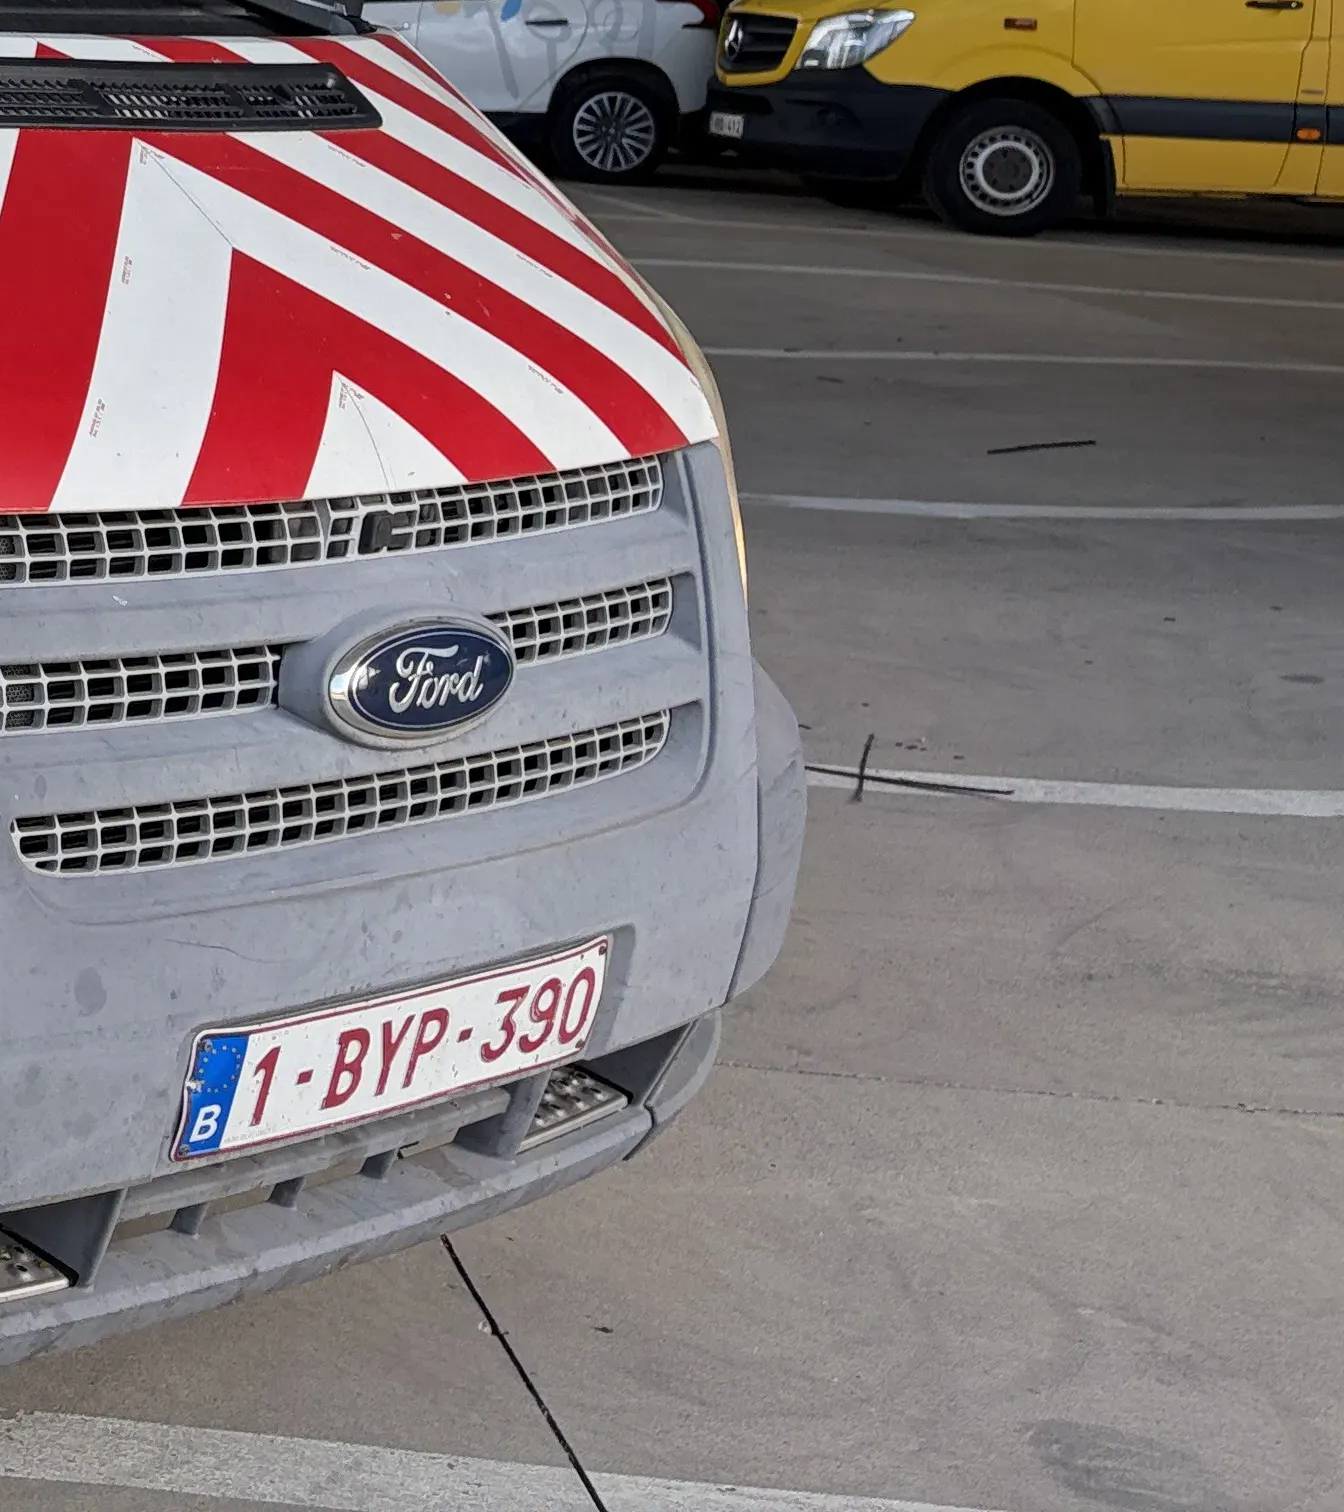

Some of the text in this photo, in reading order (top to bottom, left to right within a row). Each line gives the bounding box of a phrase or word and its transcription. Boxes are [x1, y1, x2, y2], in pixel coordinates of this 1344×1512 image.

[388, 644, 484, 714] Ford
[249, 966, 596, 1127] 1-BYP-390
[189, 1104, 221, 1143] B
